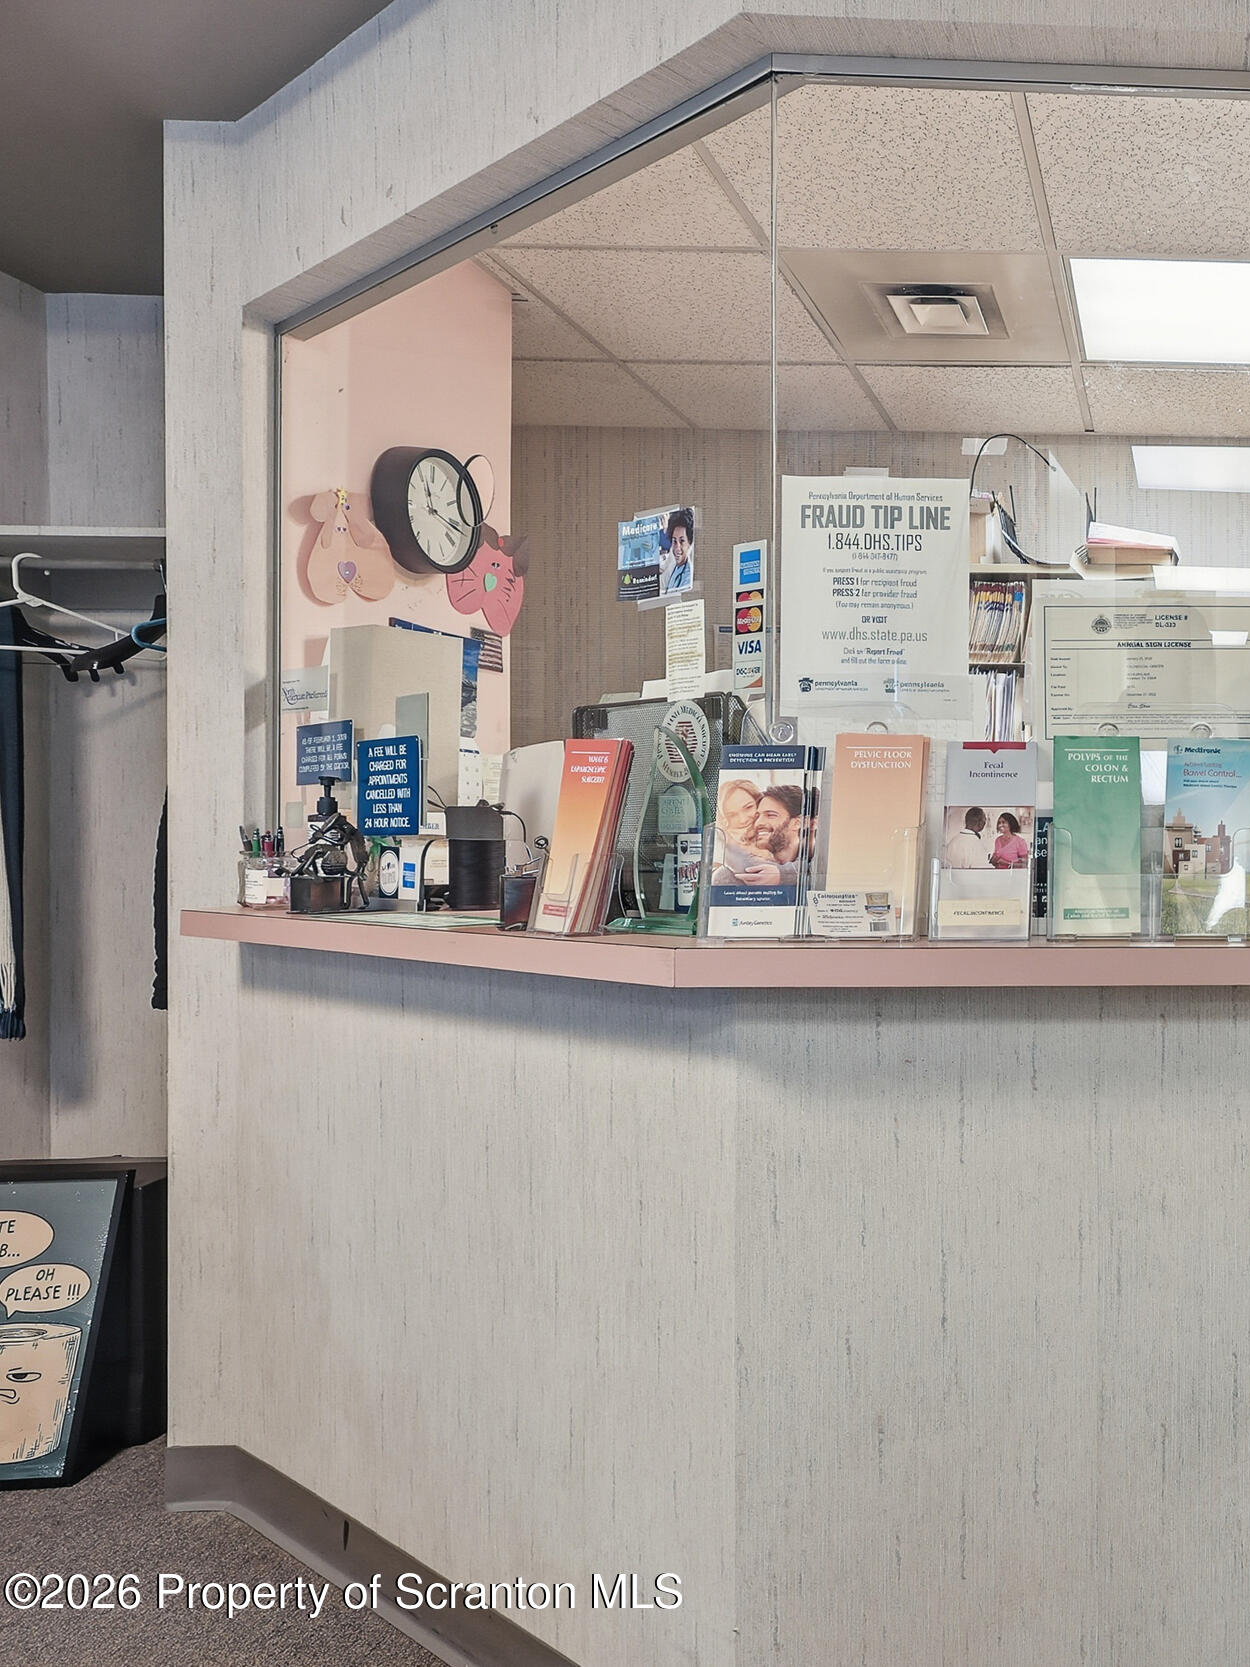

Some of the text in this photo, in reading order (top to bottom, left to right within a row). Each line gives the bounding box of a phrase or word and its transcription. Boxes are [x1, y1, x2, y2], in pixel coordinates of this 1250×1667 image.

[848, 491, 885, 502] Department
[894, 492, 915, 501] Human
[916, 492, 943, 502] Services
[801, 504, 951, 530] FRAUD TIP LINE
[622, 522, 658, 536] Medicare
[828, 533, 922, 551] 1.844.DHS.TIPS
[832, 577, 855, 586] PRESS
[856, 577, 859, 586] 1
[860, 577, 870, 586] for
[900, 578, 917, 588] fraud
[832, 588, 917, 599] PRESS 2 for provider fraud
[861, 615, 870, 623] OR
[822, 627, 928, 644] www.dhs.state.pa.us
[737, 640, 762, 654] VISA
[368, 744, 407, 758] A FEE WILL BE
[854, 751, 912, 759] PELVIC FLOOR
[1068, 753, 1101, 761] POLYPS
[369, 758, 407, 772] CHARGED FOR
[850, 760, 912, 769] DYSFUNCTION
[984, 761, 1003, 769] Fecal
[1085, 764, 1128, 772] COLON &
[969, 770, 1018, 778] Incontinence
[1183, 768, 1206, 776] Bowel
[367, 773, 408, 786] APPOINTMENTS
[1091, 775, 1129, 783] RECTUM
[365, 787, 411, 800] CANCELLED WITH
[372, 803, 403, 814] LESS THAN
[364, 818, 372, 828] 24
[373, 817, 388, 828] HOUR
[389, 816, 411, 828] NOTICE.
[0, 1219, 17, 1234] TE
[36, 1268, 56, 1281] OH
[5, 1283, 81, 1302] PLEASE !!!
